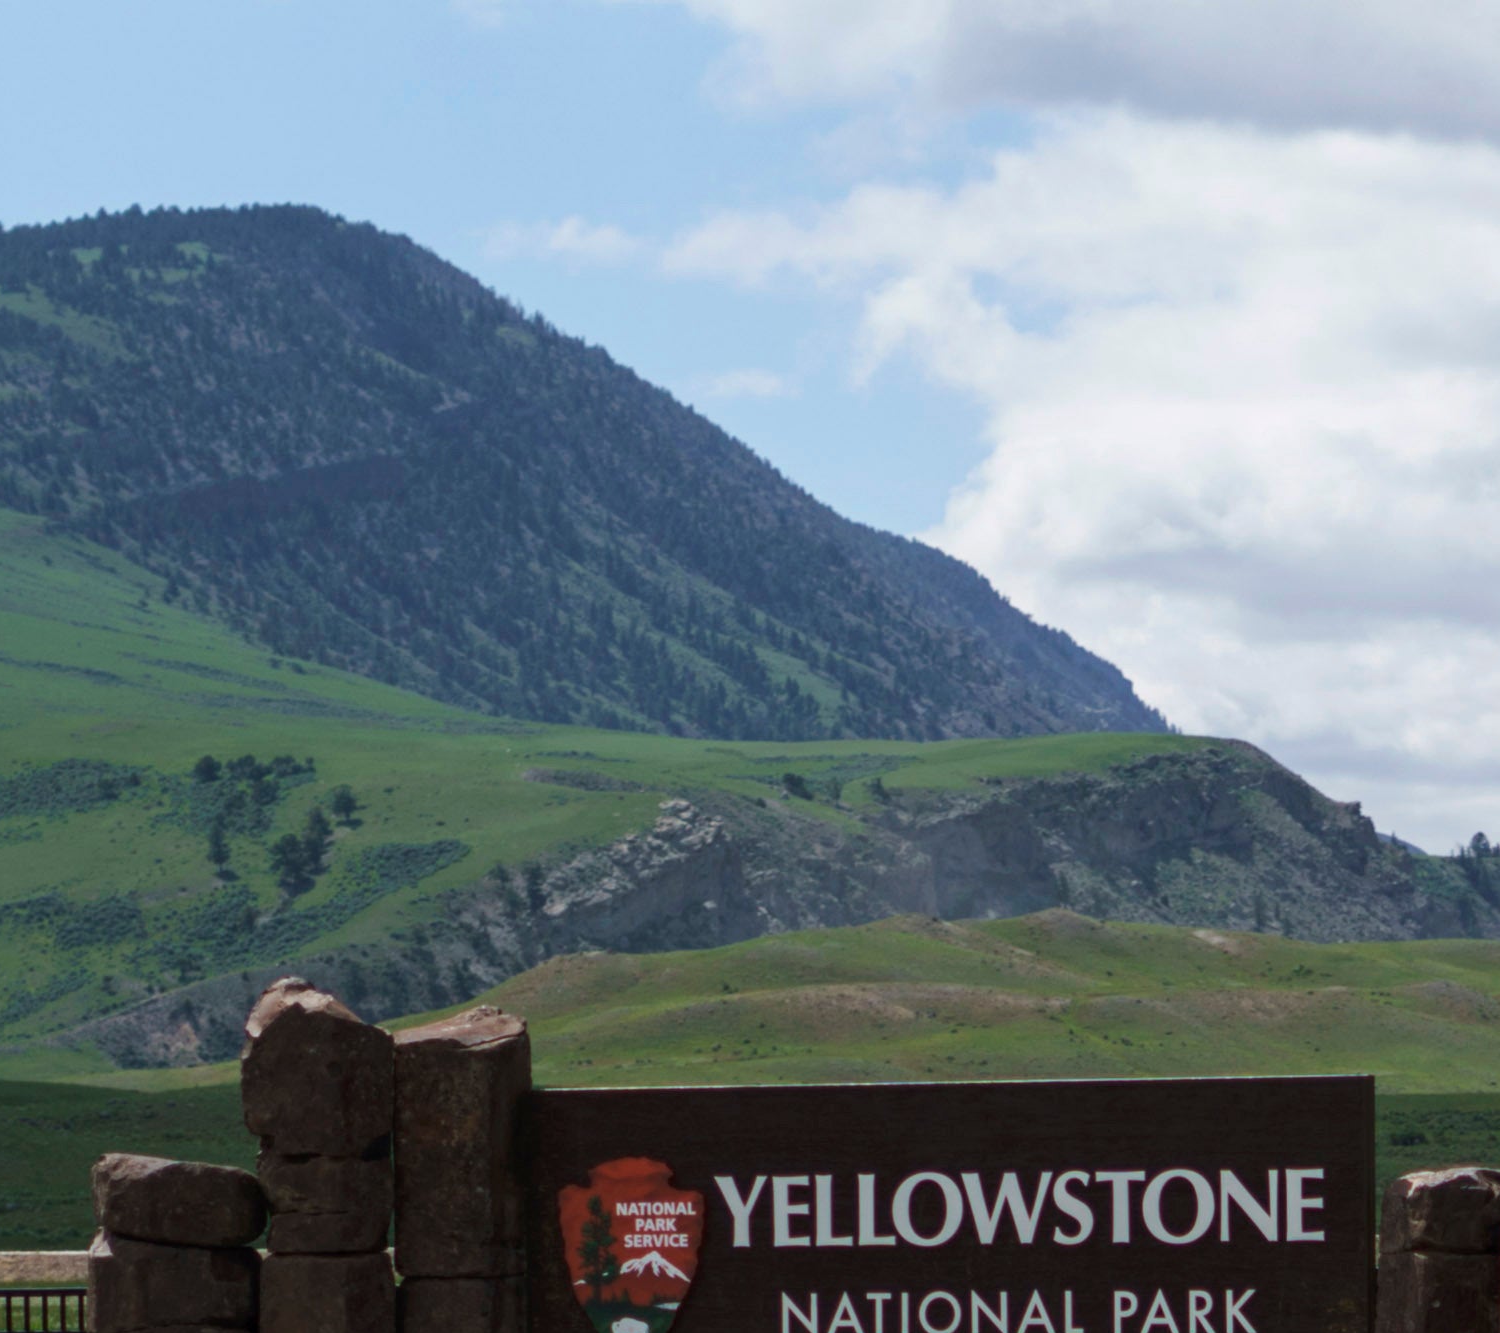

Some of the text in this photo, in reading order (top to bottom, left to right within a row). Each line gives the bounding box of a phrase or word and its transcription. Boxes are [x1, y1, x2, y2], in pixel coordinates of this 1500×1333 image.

[614, 1201, 697, 1217] NATIONAL
[713, 1167, 1325, 1248] YELLOWSTONE
[634, 1217, 677, 1232] PARK
[623, 1232, 689, 1248] SERVICE
